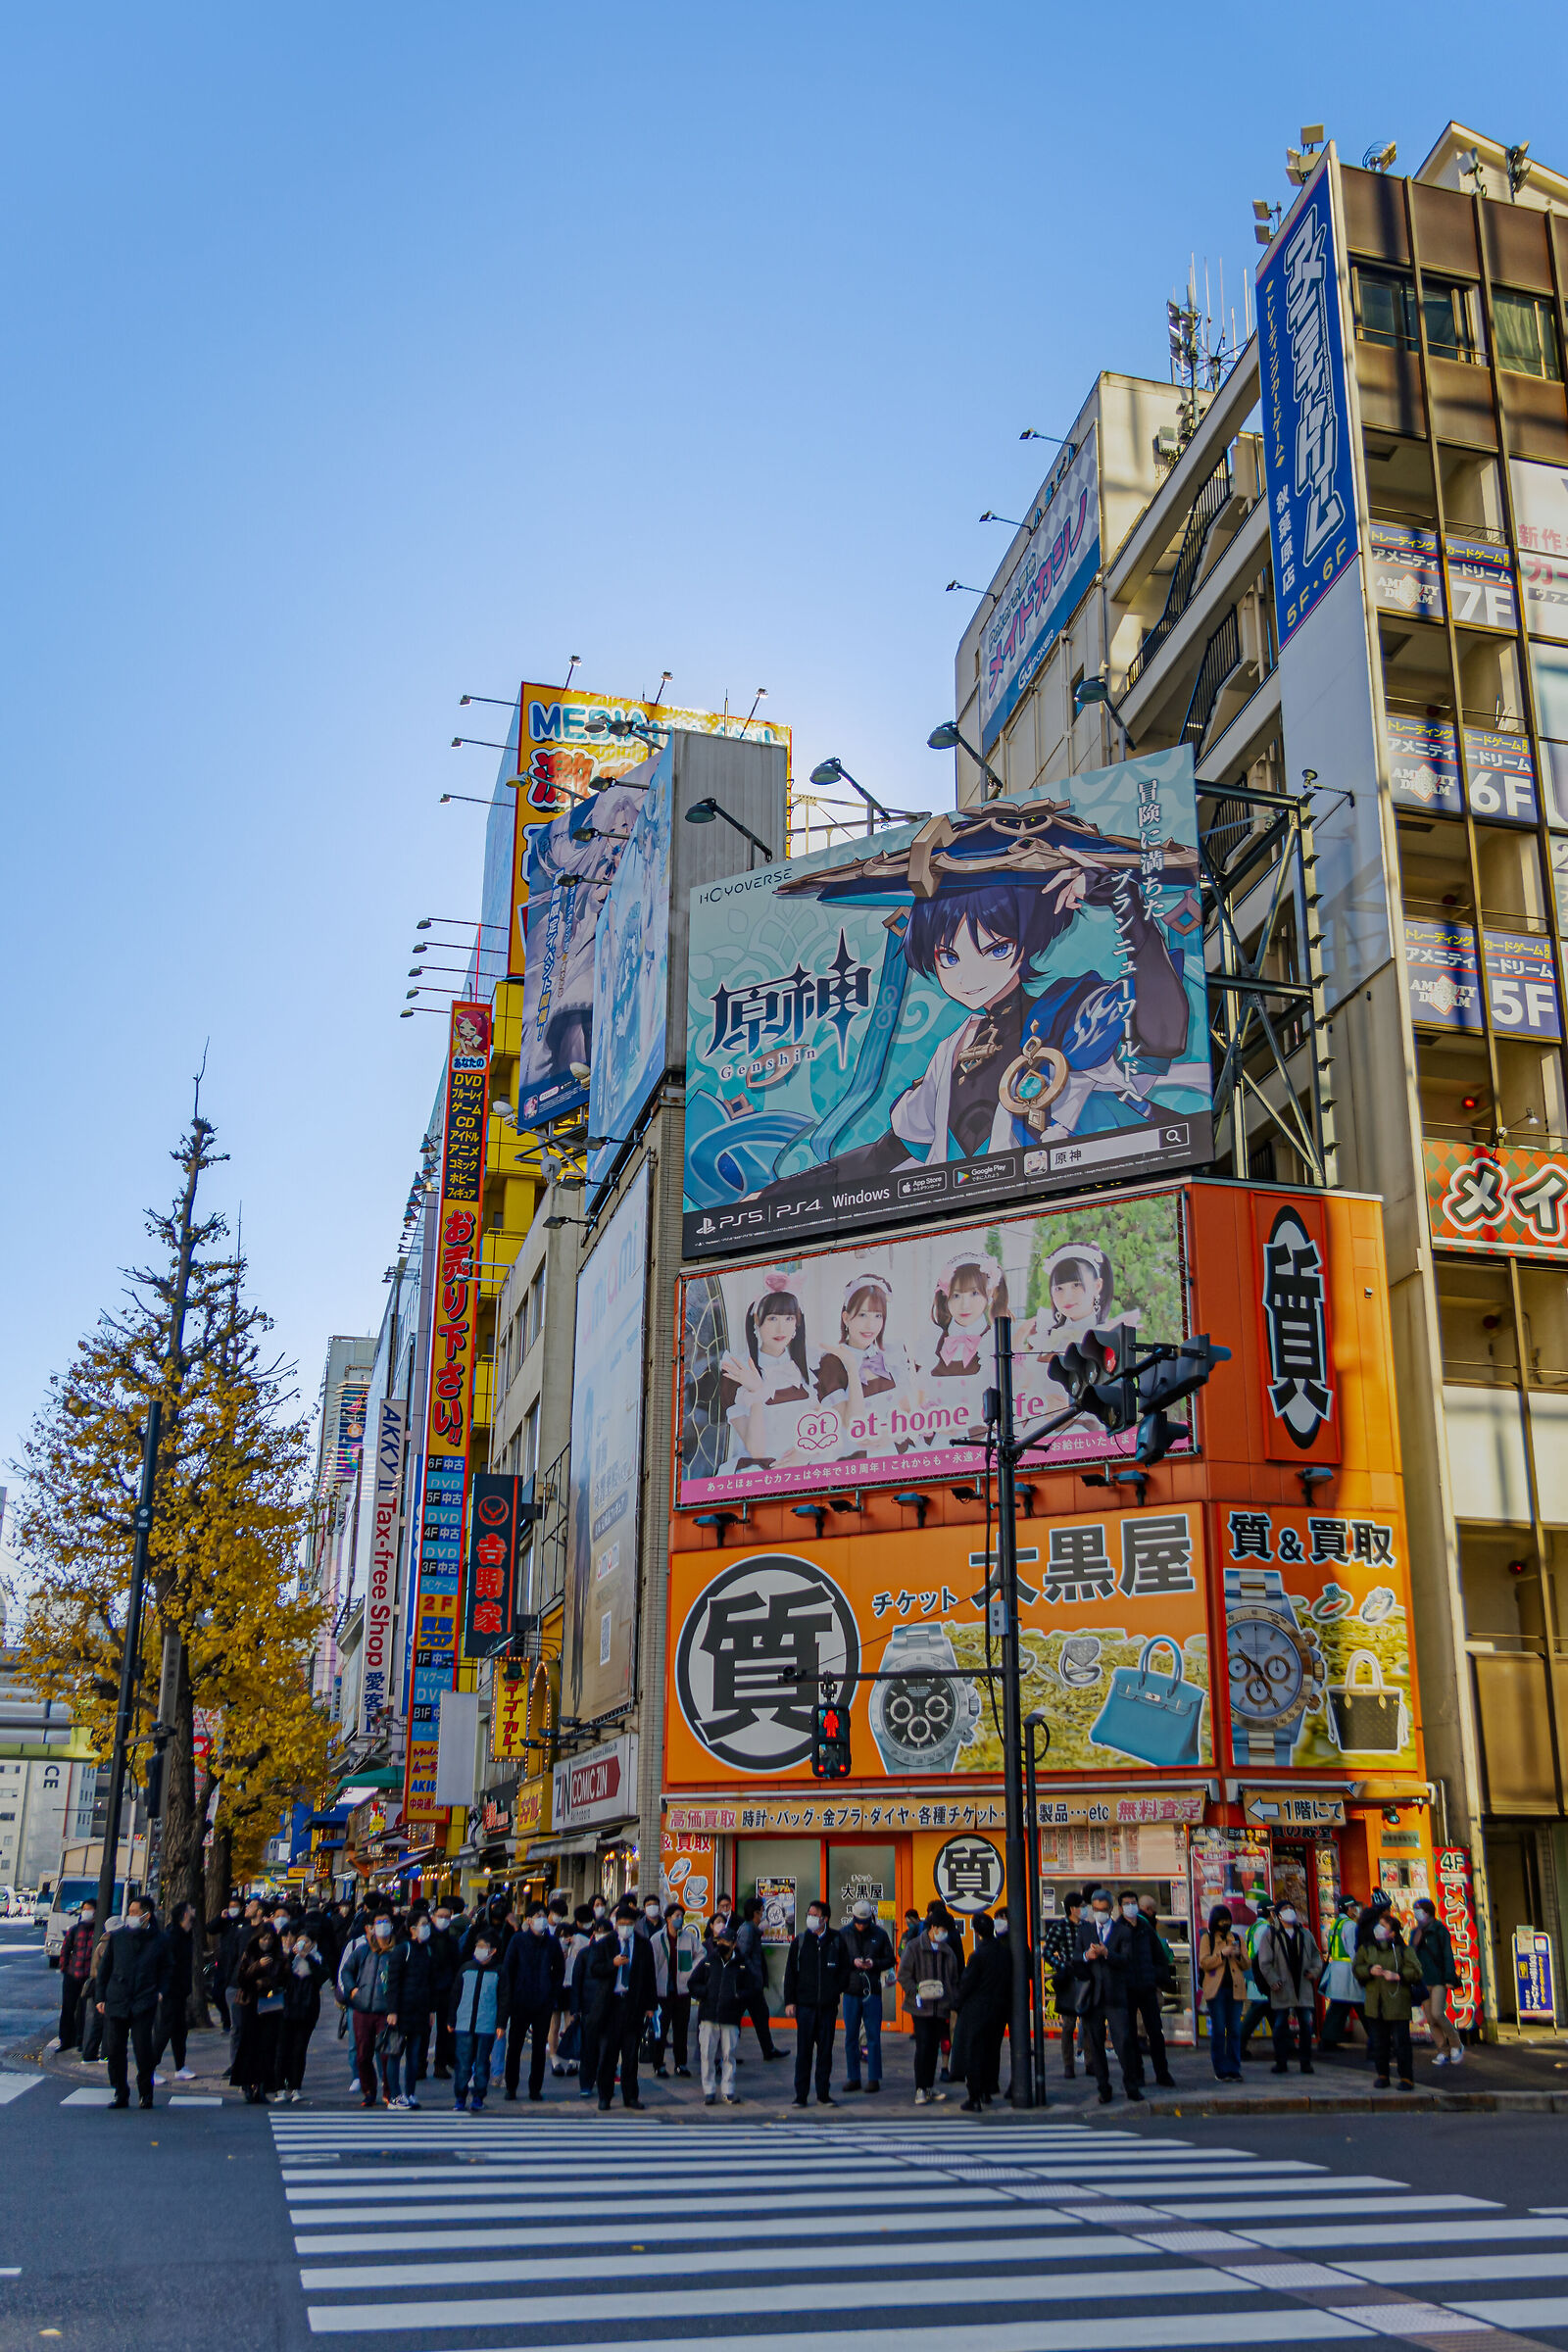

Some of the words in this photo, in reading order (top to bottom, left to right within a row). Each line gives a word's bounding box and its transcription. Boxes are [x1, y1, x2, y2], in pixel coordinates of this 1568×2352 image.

[1276, 484, 1296, 597] 秋葉原店
[1372, 530, 1436, 551] トレーディング
[1446, 545, 1503, 564] カードゲーム
[1518, 523, 1568, 553] 新作
[1372, 548, 1438, 571] アメニティ
[1452, 581, 1512, 626] 7F
[1388, 720, 1453, 739] トレーディング
[1464, 732, 1521, 751] カードゲーム
[1388, 737, 1455, 760] アメニティ
[1469, 771, 1533, 817] 6F
[1137, 779, 1165, 921] 冒険に満ちた
[699, 868, 793, 905] HOYOVERSE
[1405, 928, 1474, 947] トレーディング
[1484, 939, 1544, 956] カードゲーム
[1405, 947, 1475, 969] アメニティ
[1111, 868, 1144, 1102] ブランニューワールドへ
[705, 927, 872, 1070] 原神
[1491, 979, 1554, 1027] 5F
[453, 1056, 485, 1069] あなたの
[720, 1048, 816, 1080] Genshin
[454, 1073, 482, 1087] DVD
[451, 1088, 483, 1101] ブルーレイ
[451, 1102, 482, 1115] ゲーム
[456, 1116, 476, 1129] CD
[450, 1130, 480, 1144] アイドル
[449, 1144, 480, 1156] アニメ
[1054, 1150, 1082, 1165] 原神
[448, 1158, 478, 1171] コミック
[971, 1165, 992, 1177] Google
[449, 1173, 476, 1186] ホビー
[912, 1178, 926, 1187] App
[927, 1175, 943, 1185] Store
[447, 1188, 476, 1200] フィギュア
[718, 1209, 764, 1229] PS5
[776, 1199, 824, 1219] PS4
[832, 1186, 890, 1209] Windows
[1261, 1237, 1333, 1422] 質
[802, 1418, 828, 1436] at
[850, 1404, 969, 1440] at-home
[380, 1403, 402, 1476] AKKY
[427, 1457, 443, 1470] 6F
[443, 1458, 465, 1471] 中古
[430, 1479, 461, 1489] DVD
[426, 1492, 440, 1504] 5F
[441, 1493, 463, 1505] 中古
[427, 1512, 460, 1524] DVD
[423, 1526, 438, 1539] 4F
[439, 1527, 461, 1540] 中古
[1226, 1510, 1397, 1568] 質&買取
[371, 1497, 398, 1602] Tax-free
[425, 1546, 457, 1558] DVD
[421, 1561, 436, 1574] 3F
[437, 1562, 459, 1575] 中古
[870, 1585, 959, 1619] チケット
[968, 1513, 1197, 1607] 大黒屋
[421, 1580, 456, 1592] PCゲーム
[472, 1532, 508, 1635] 吉野家
[423, 1595, 453, 1611] 2F
[366, 1604, 392, 1668] Shop
[419, 1634, 454, 1647] フロア
[416, 1652, 431, 1664] 1F
[693, 1581, 836, 1747] 質
[416, 1671, 451, 1683] TVゲーム
[364, 1671, 385, 1712] 愛客
[416, 1688, 444, 1701] DV
[414, 1706, 431, 1719] B1F
[502, 1678, 525, 1756] ゴーゴーカレー
[572, 1767, 596, 1804] COMIC
[669, 1808, 736, 1830] 高価買取
[1115, 1796, 1202, 1823] 無料査定
[1282, 1798, 1345, 1823] 1階にて
[1441, 1851, 1465, 1872] 4F
[941, 1843, 1000, 1906] 質
[841, 1882, 884, 1900] 大黒屋
